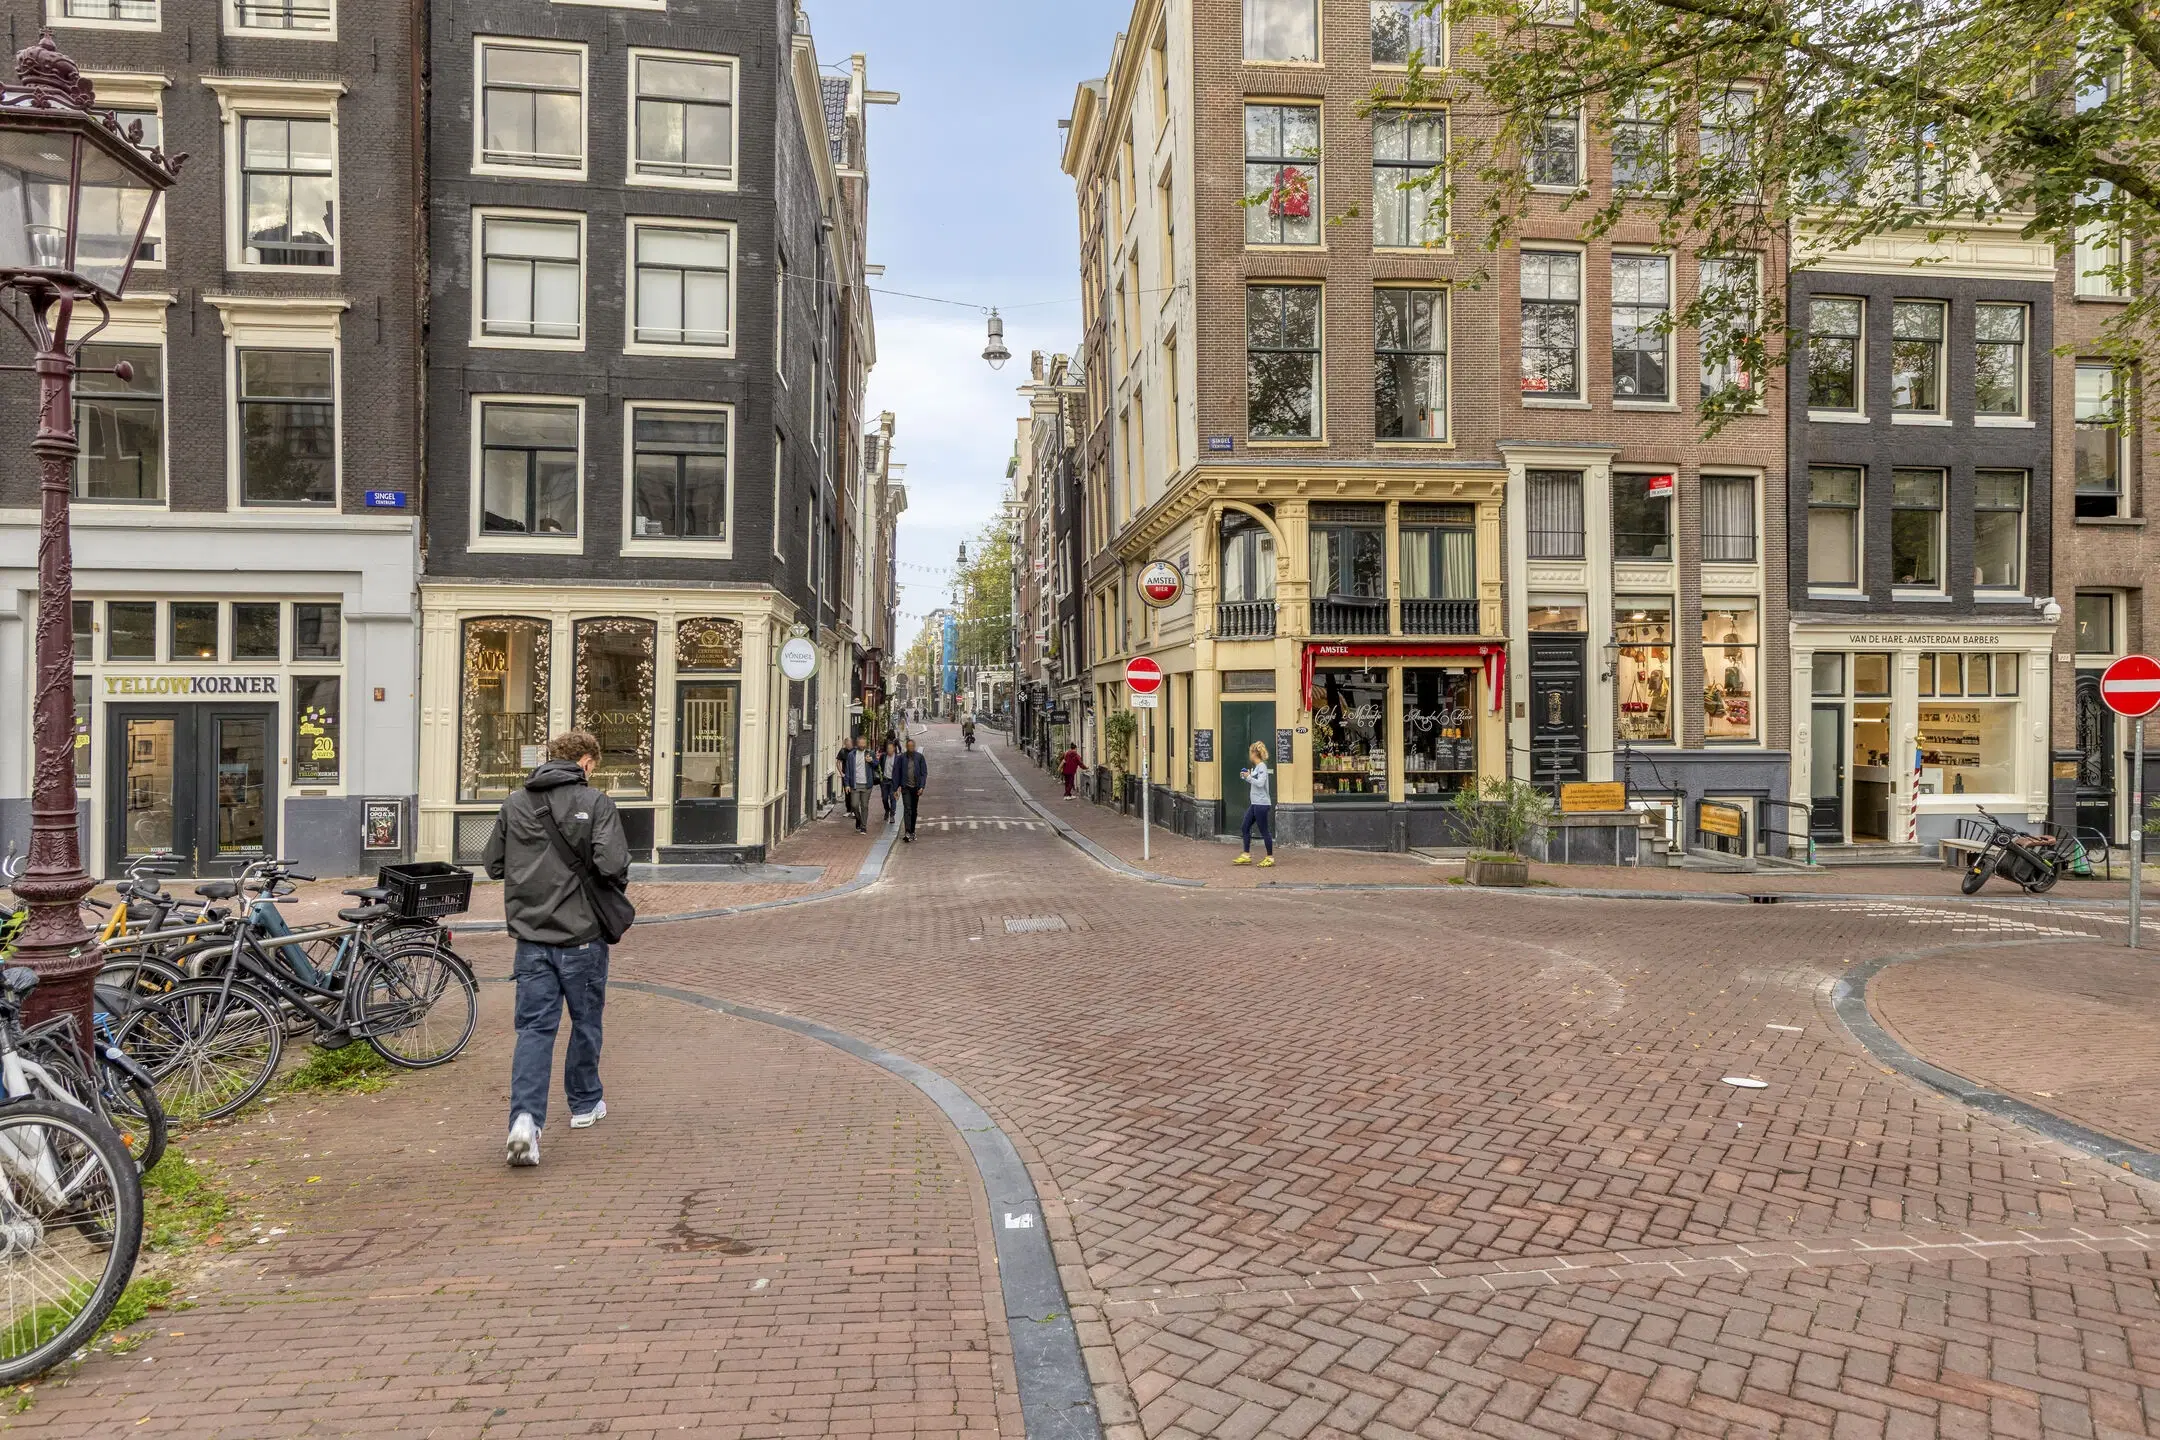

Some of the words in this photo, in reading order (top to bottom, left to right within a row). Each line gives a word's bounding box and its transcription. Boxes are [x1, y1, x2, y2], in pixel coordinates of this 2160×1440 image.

[374, 492, 395, 500] SINGEL
[1850, 635, 1866, 643] VAN
[1868, 635, 1880, 643] DE
[1882, 635, 1903, 643] HARE
[1907, 635, 1960, 644] AMSTERDAM
[1963, 635, 1999, 644] BARBERS
[104, 676, 277, 694] YELLOWKORNER
[316, 739, 331, 751] 20
